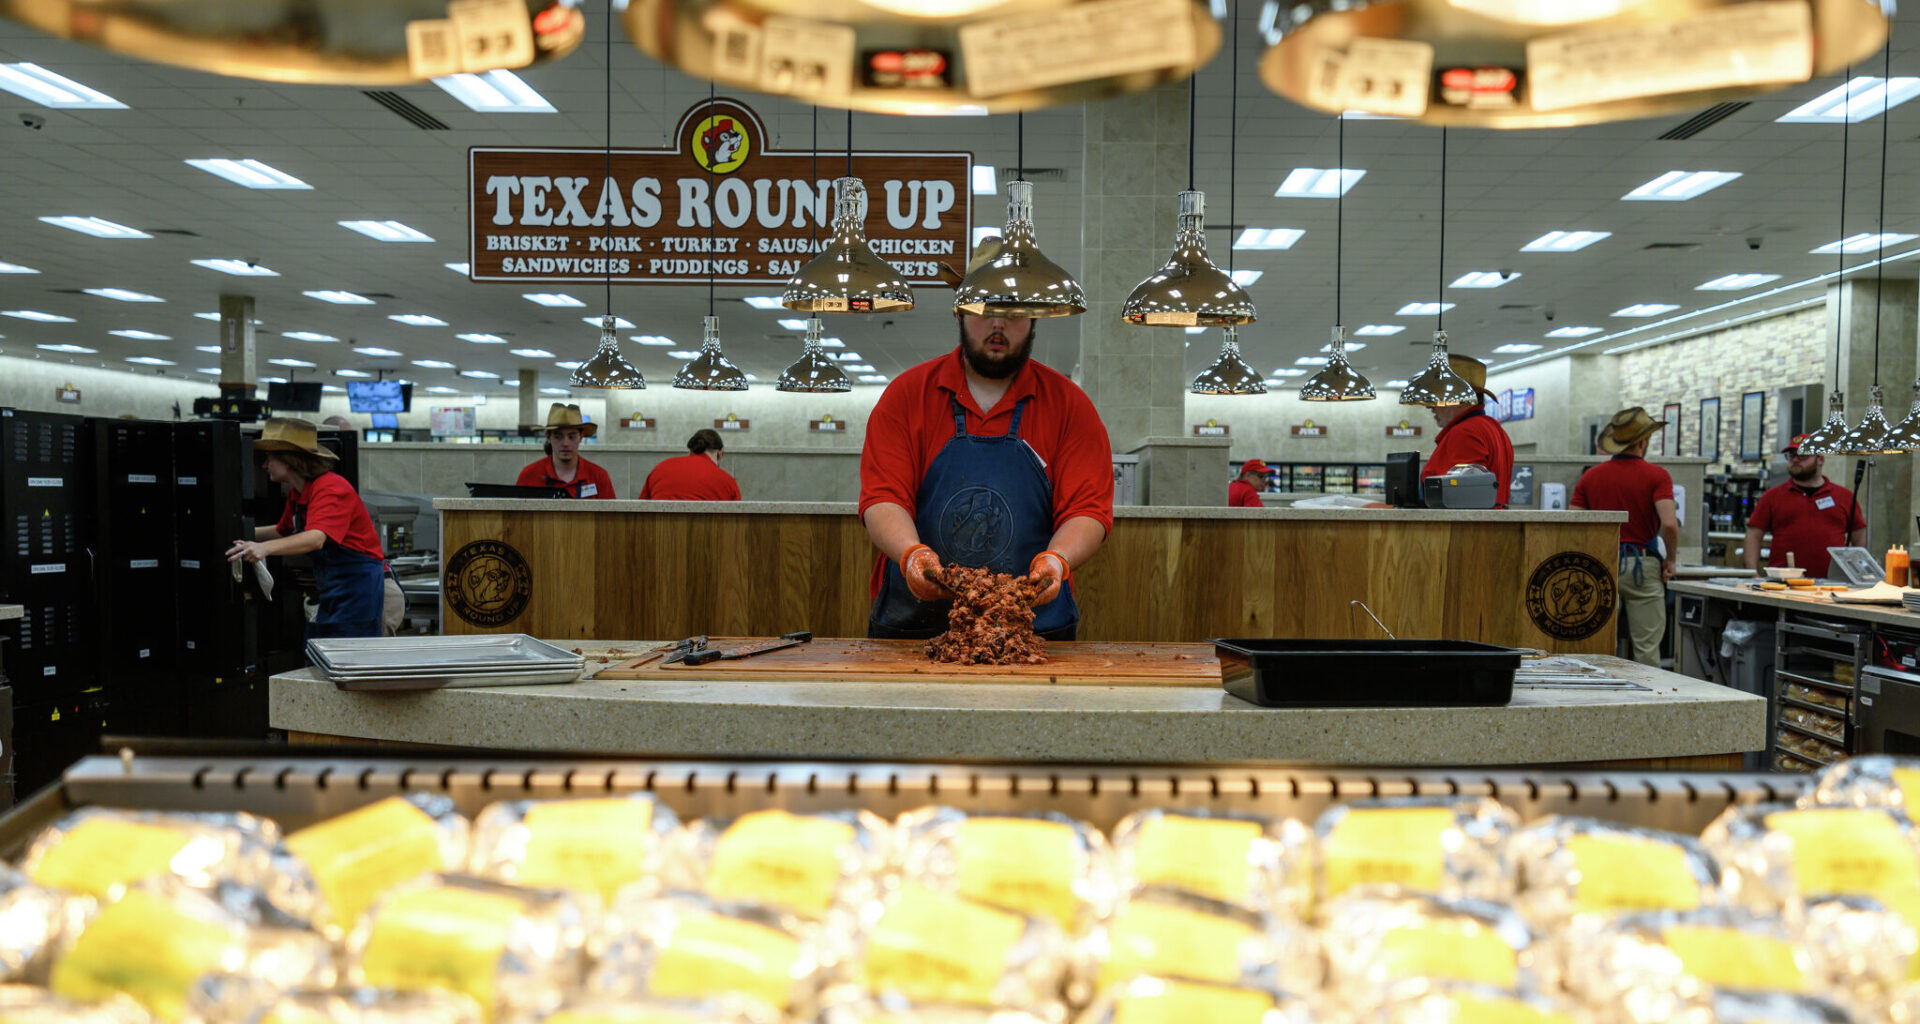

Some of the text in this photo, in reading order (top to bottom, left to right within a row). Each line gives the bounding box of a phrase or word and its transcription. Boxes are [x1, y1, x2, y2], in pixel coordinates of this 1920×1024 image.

[486, 175, 662, 228] TEXAS
[884, 179, 955, 230] UP
[486, 235, 569, 251] BRISKET
[589, 237, 642, 252] PORK
[662, 237, 739, 253] TURKEY
[868, 239, 955, 255] CHICKEN
[502, 257, 630, 273] SANDWICHES
[650, 259, 749, 274] PUDDINGS
[464, 544, 504, 557] TEXAS
[1546, 557, 1589, 569] TEXAS
[464, 606, 504, 622] ROUND
